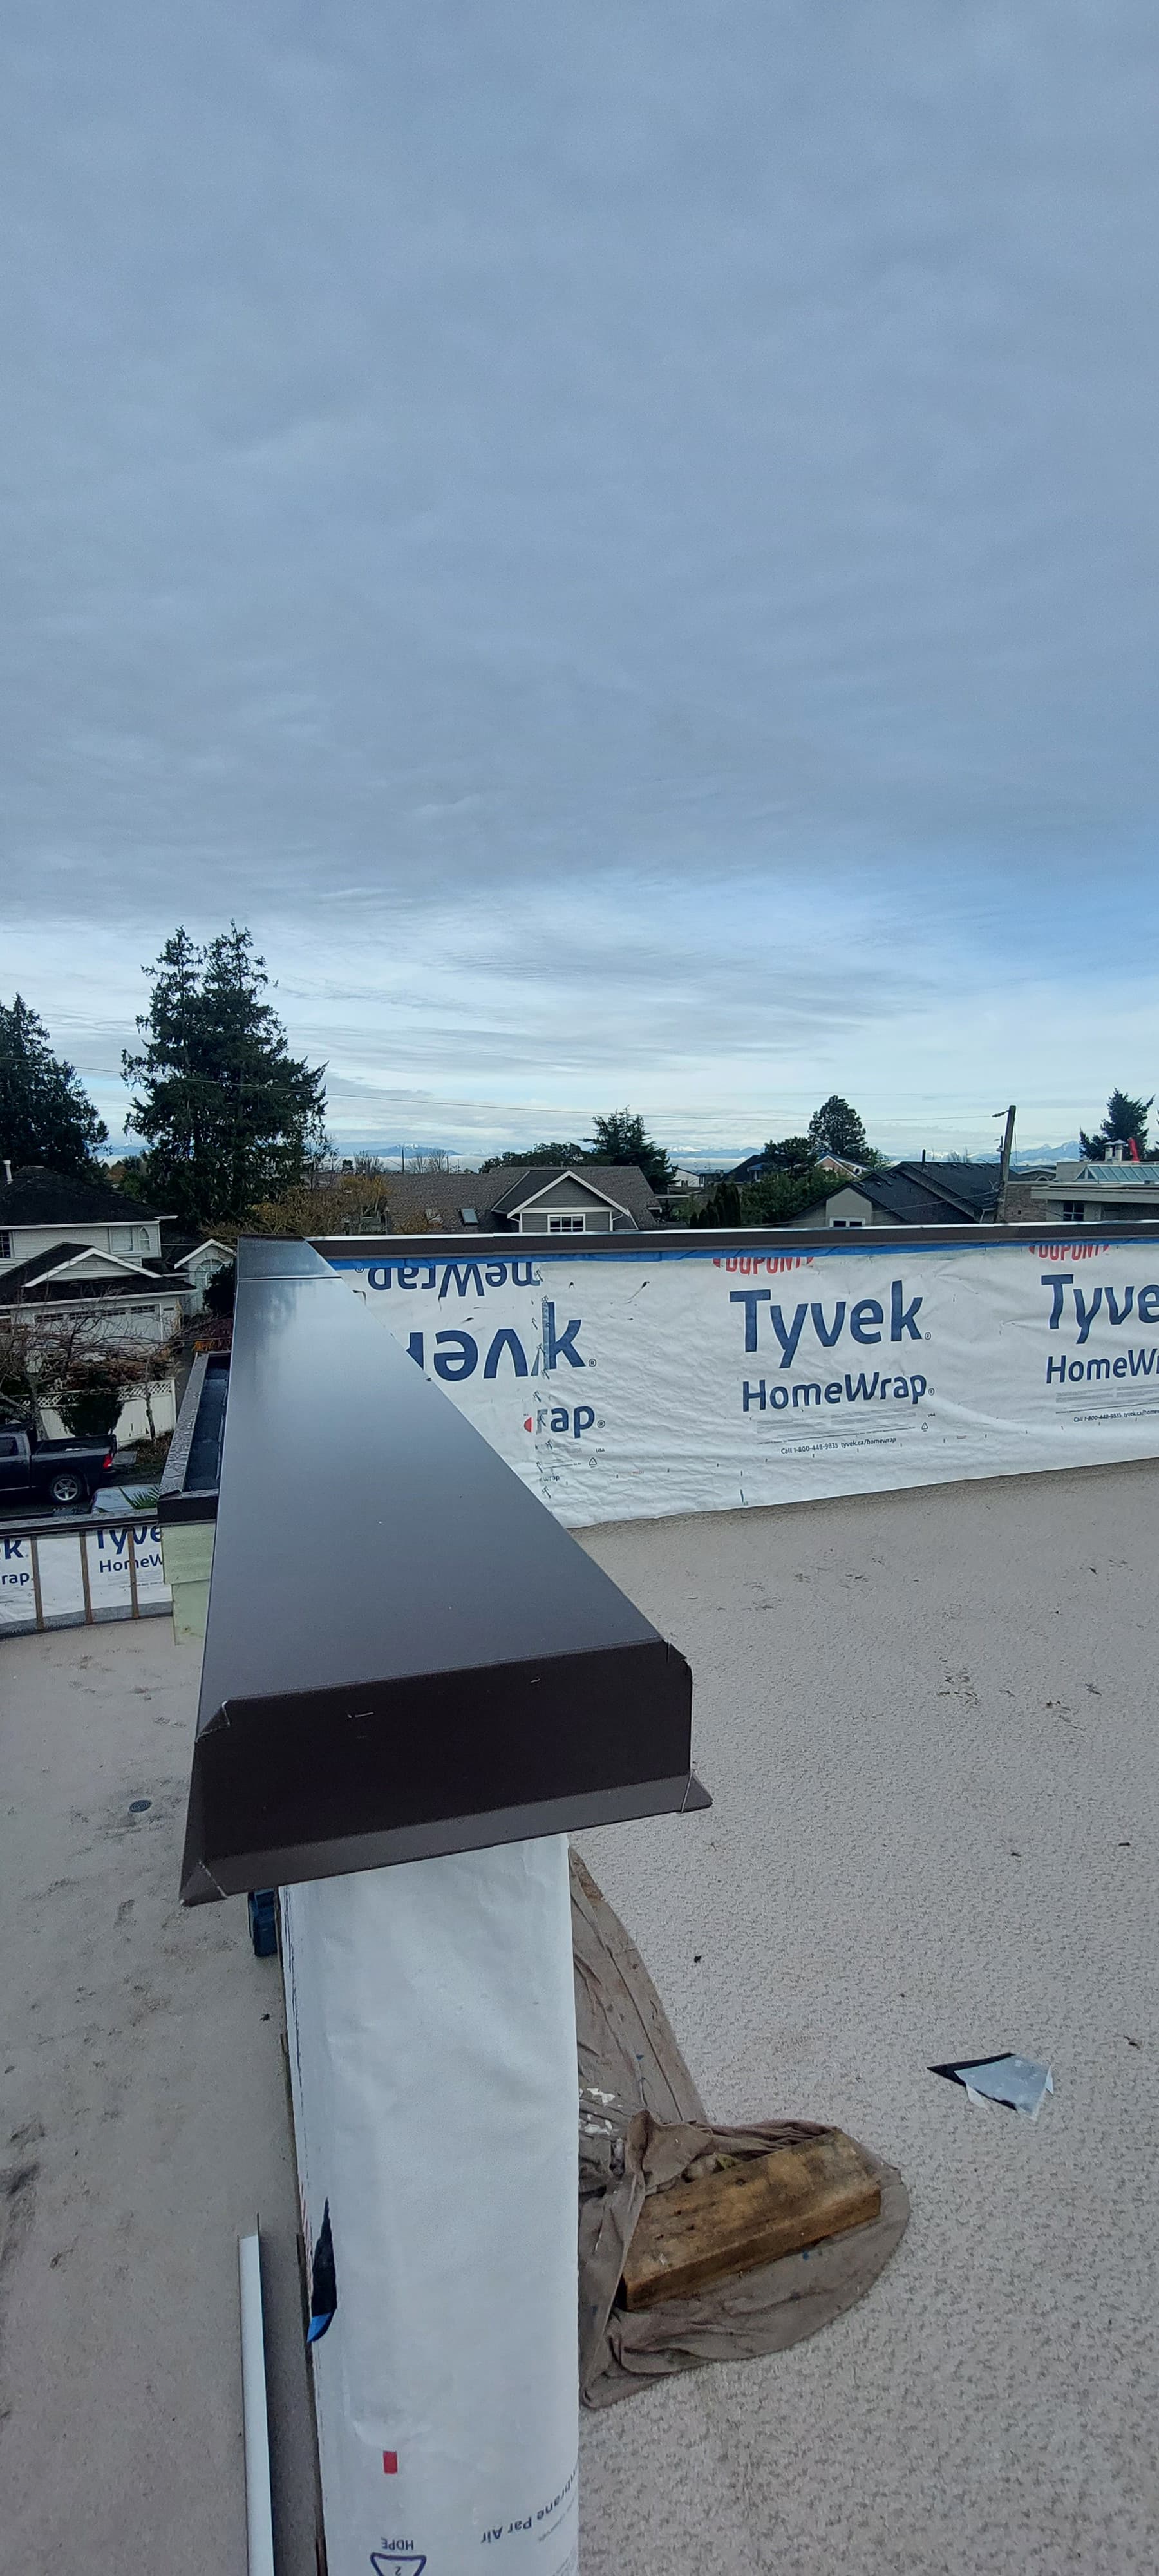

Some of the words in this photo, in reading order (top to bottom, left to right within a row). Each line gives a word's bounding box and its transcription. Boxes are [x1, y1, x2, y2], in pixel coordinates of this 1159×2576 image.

[793, 1441, 839, 1454] 1-800-448-9835
[841, 1436, 897, 1448] tyvek.ca/homewrap
[507, 2516, 532, 2533] Par
[480, 2526, 503, 2544] Air
[381, 2537, 414, 2551] HDPE
[395, 2566, 402, 2576] 2
